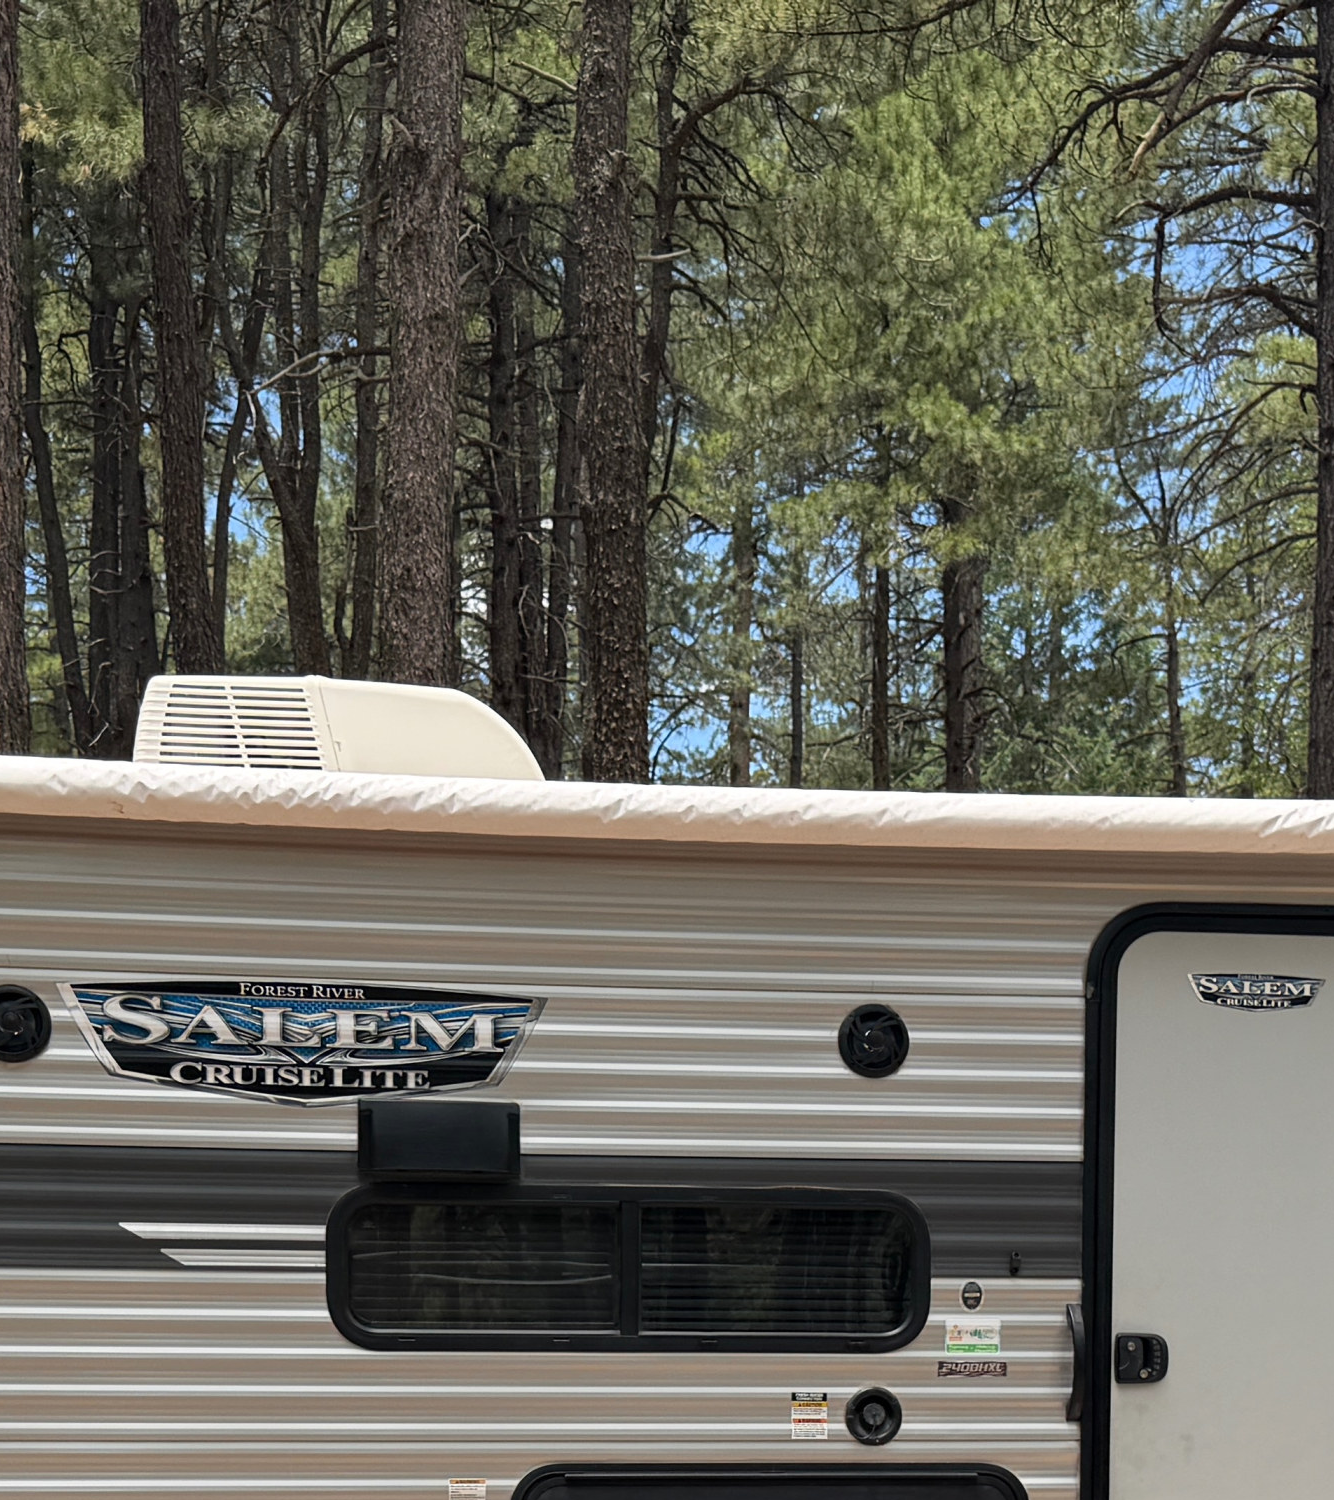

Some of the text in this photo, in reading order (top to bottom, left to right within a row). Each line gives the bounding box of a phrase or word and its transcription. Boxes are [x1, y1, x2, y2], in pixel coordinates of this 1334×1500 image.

[239, 982, 365, 1001] FOREST RIVER
[1199, 976, 1313, 997] SALEM
[102, 993, 507, 1054] SALEM
